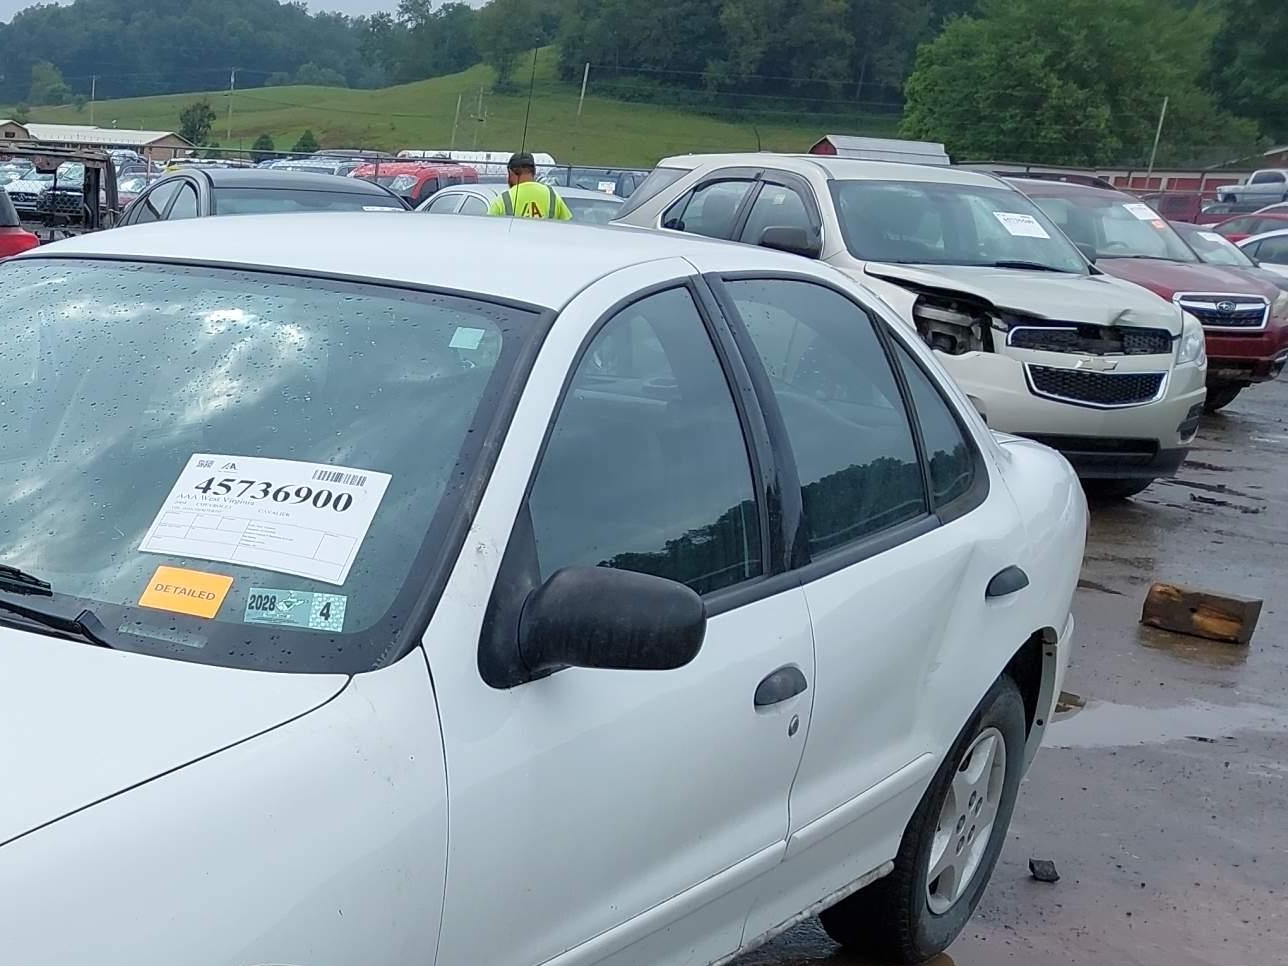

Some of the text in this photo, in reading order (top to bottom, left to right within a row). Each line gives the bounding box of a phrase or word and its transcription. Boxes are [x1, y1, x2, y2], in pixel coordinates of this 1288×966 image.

[194, 476, 353, 513] 45736900
[154, 583, 216, 600] DETAILED
[247, 594, 277, 611] 2028
[319, 602, 331, 621] 4
